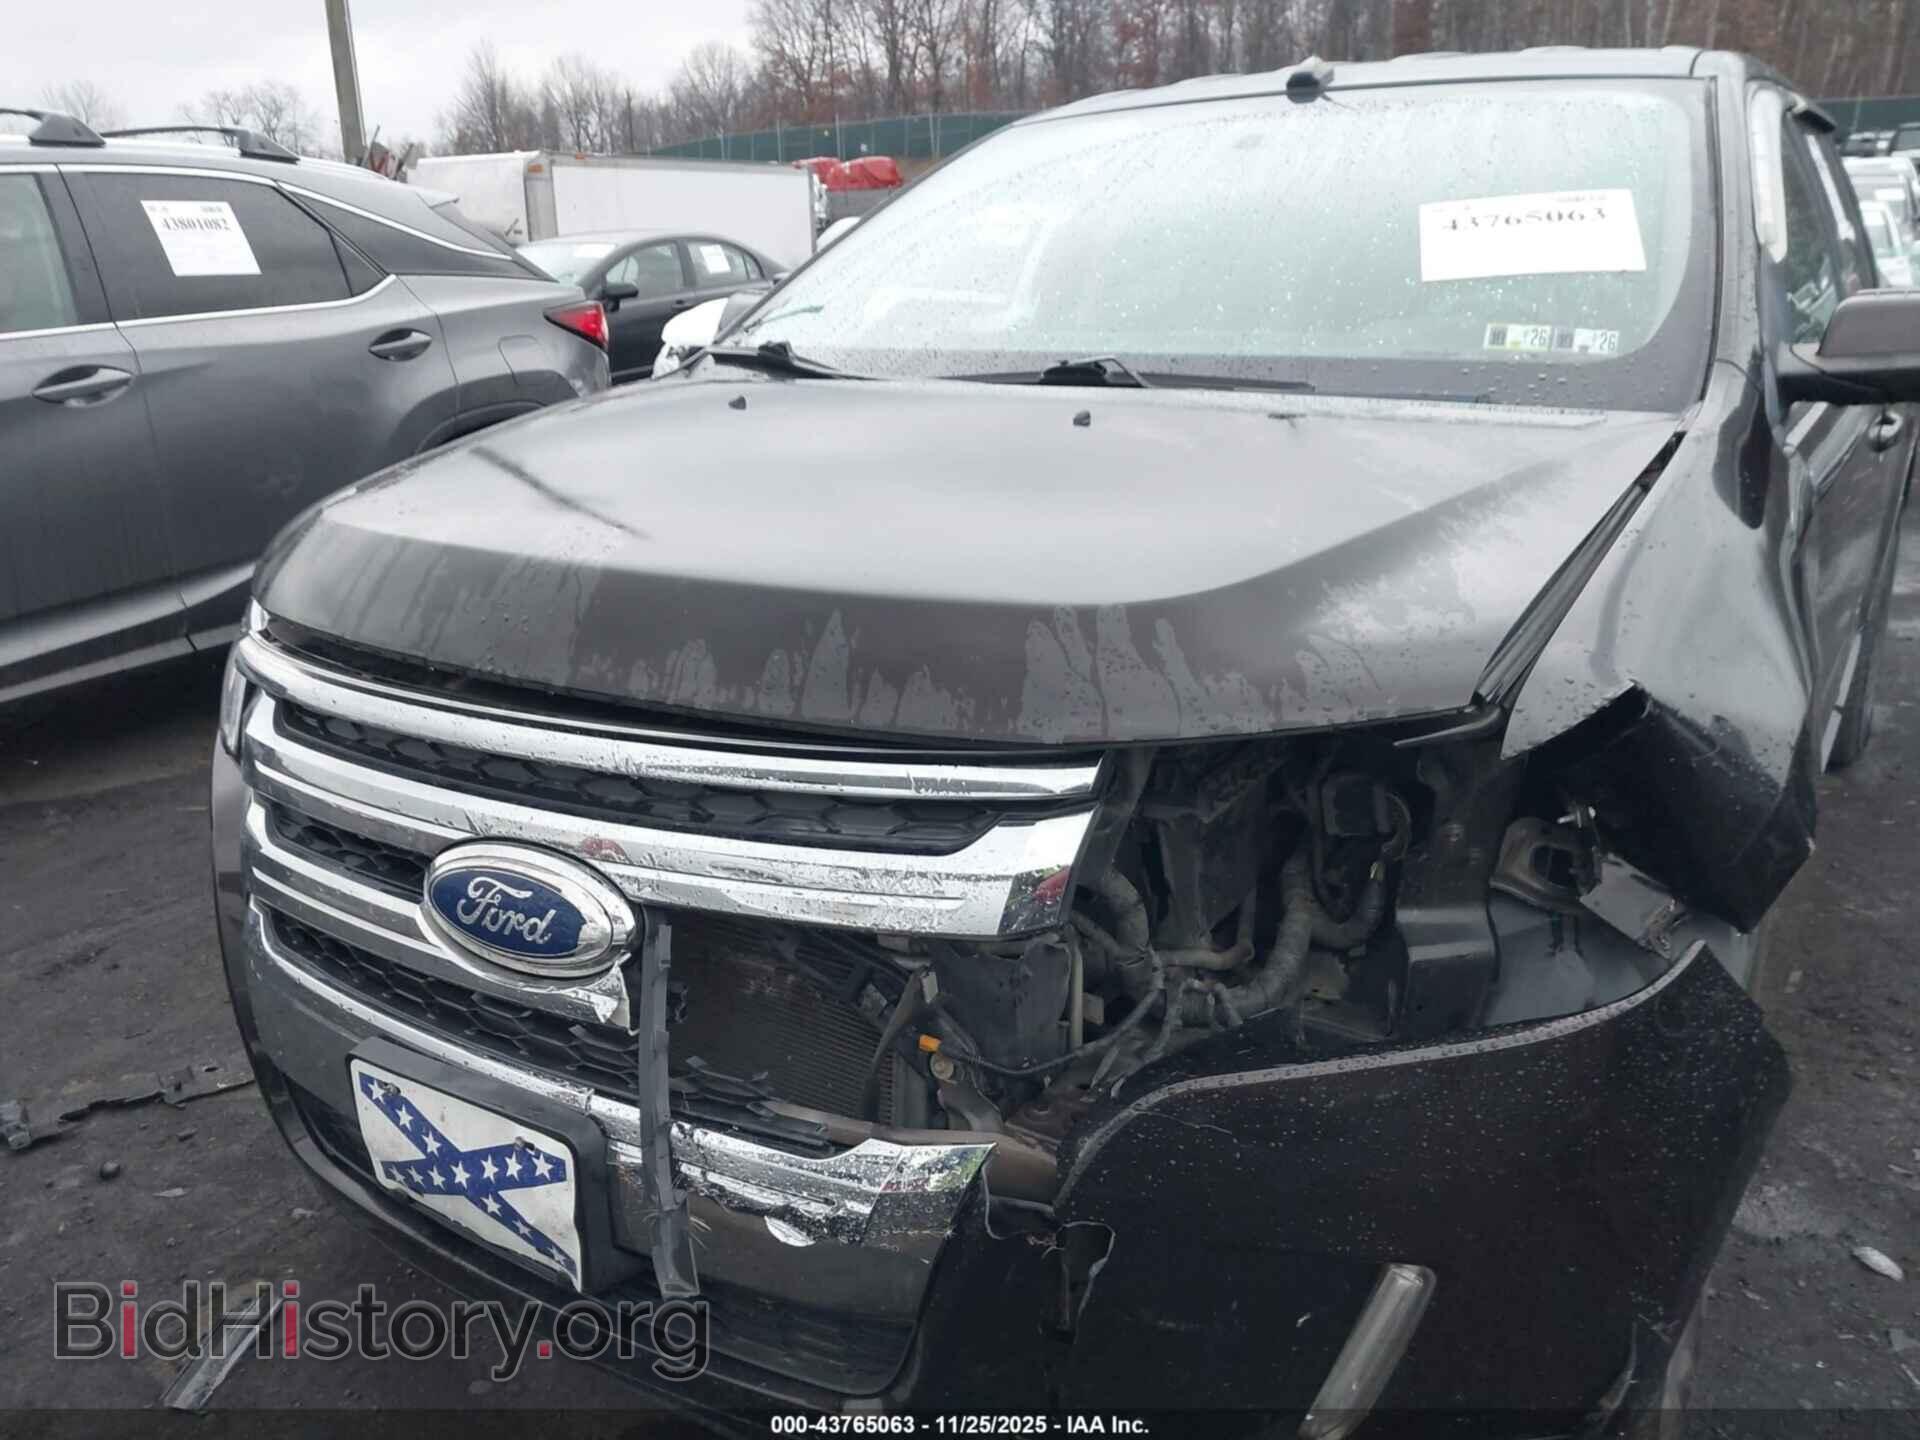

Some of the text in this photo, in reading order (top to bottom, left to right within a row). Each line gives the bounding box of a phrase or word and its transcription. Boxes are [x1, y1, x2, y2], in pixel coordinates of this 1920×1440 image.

[1441, 207, 1607, 231] 43765063
[1530, 328, 1547, 345] 26
[1600, 331, 1616, 351] 26
[456, 876, 557, 944] Ford
